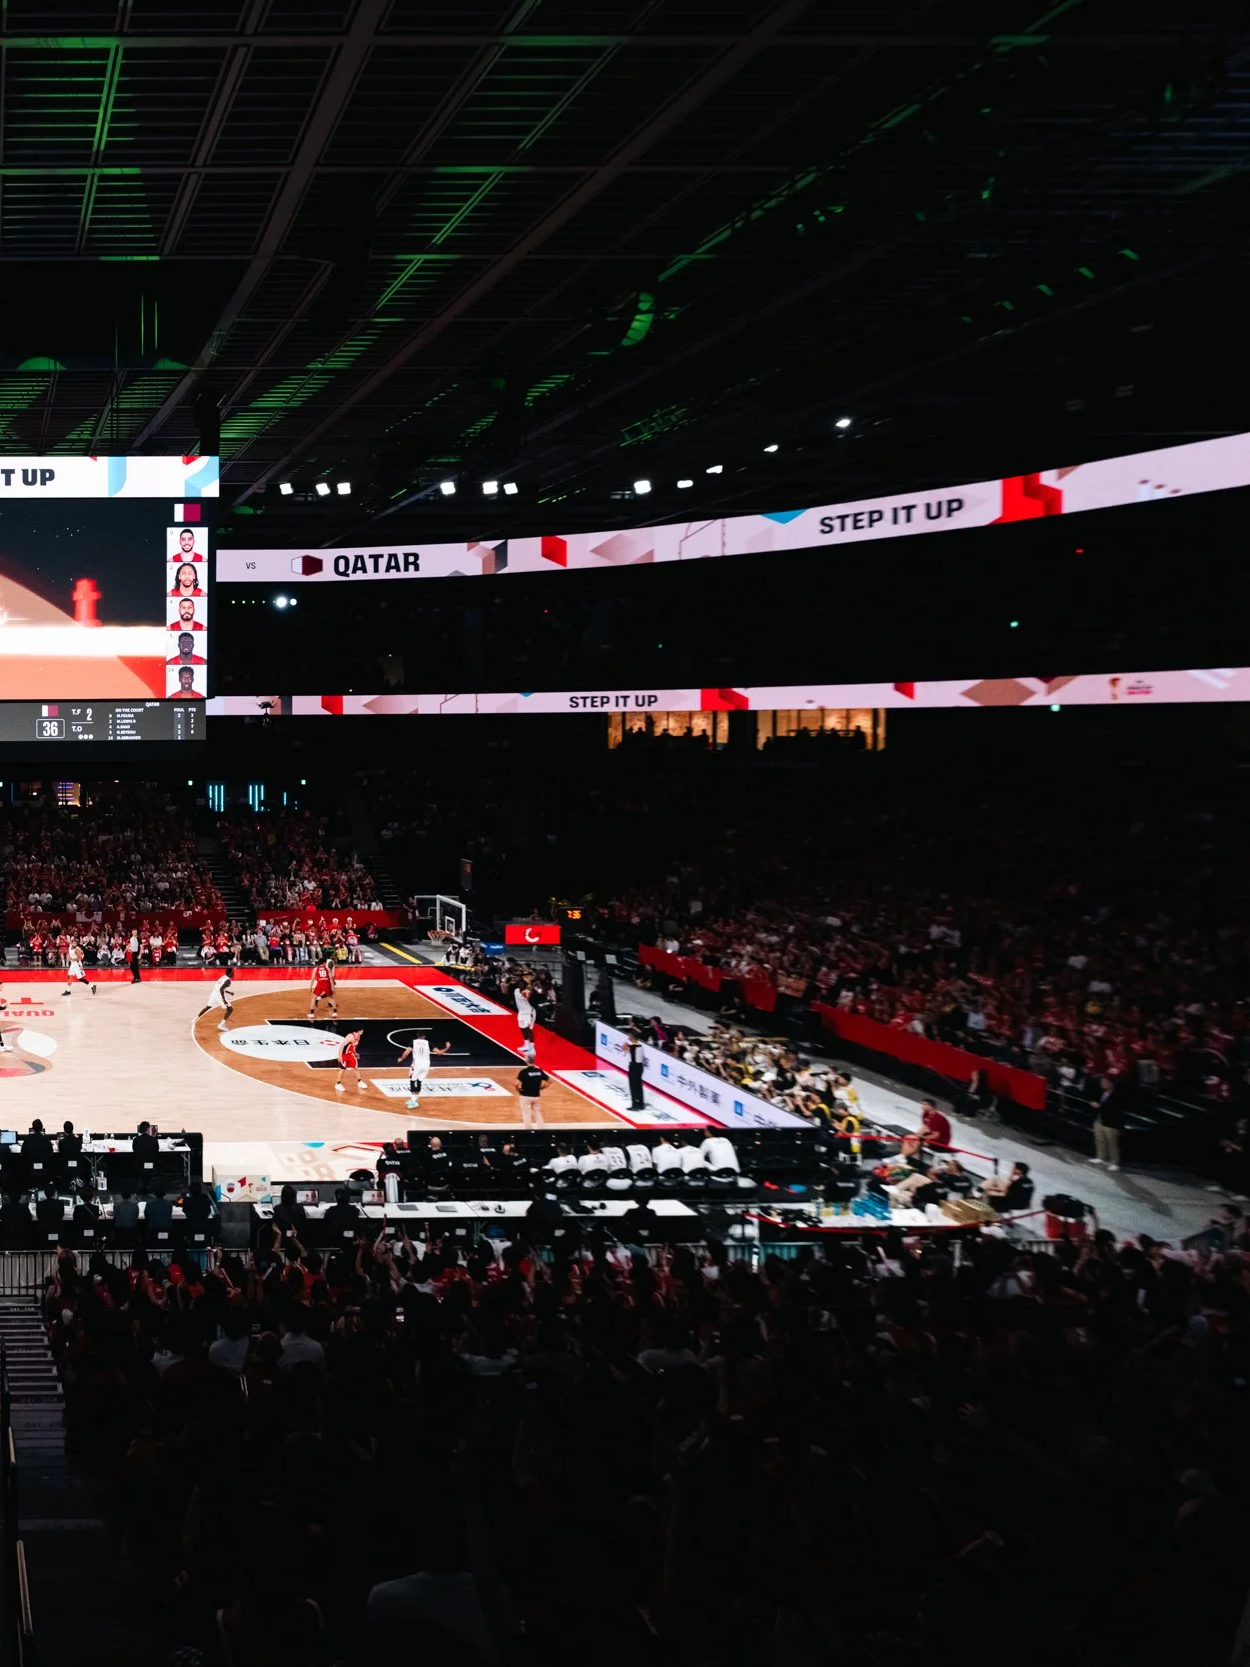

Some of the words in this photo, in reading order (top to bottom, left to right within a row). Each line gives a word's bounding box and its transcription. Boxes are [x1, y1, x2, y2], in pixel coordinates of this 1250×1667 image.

[22, 469, 55, 486] UP
[817, 506, 883, 534] STEP
[893, 505, 916, 524] IT
[926, 499, 963, 520] UP
[333, 552, 421, 578] QATAR
[570, 696, 610, 708] STEP
[615, 696, 630, 707] IT
[635, 695, 657, 707] UP
[87, 708, 92, 720] 2
[42, 721, 58, 736] 36
[567, 910, 581, 919] 7:36
[677, 1074, 721, 1106] 中外製薬
